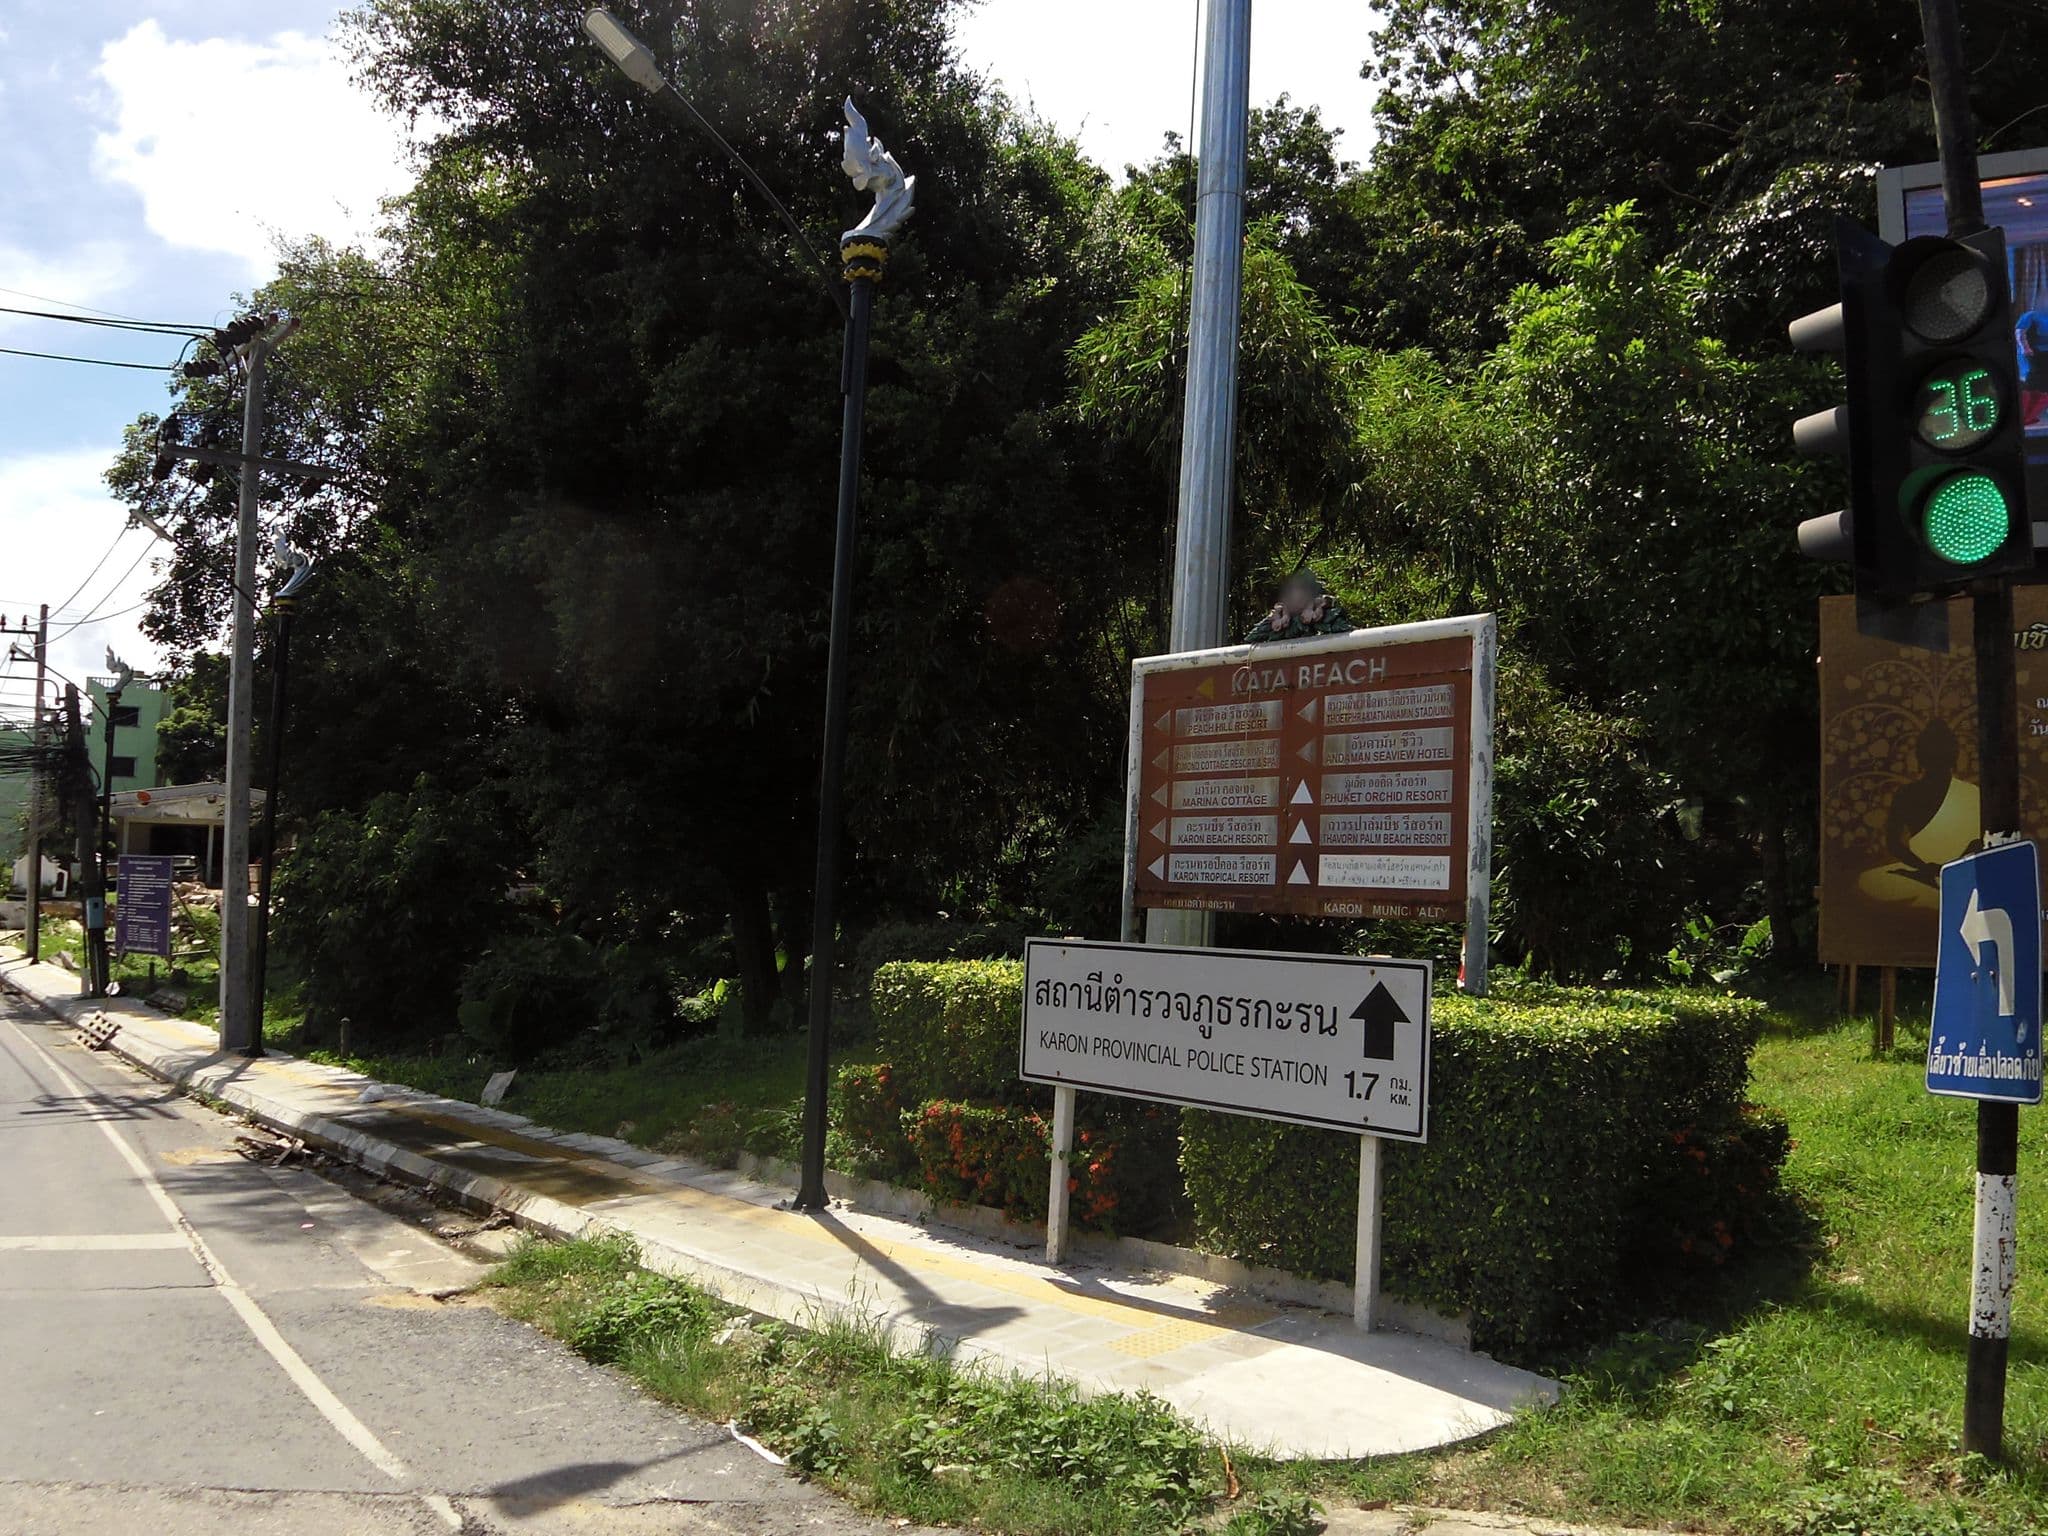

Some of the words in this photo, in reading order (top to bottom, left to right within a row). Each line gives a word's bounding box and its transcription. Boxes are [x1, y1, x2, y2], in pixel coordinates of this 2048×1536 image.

[1930, 371, 1996, 441] 36
[1232, 668, 1289, 695] KATA
[1299, 657, 1387, 690] BEACH
[1188, 724, 1214, 735] PEACH
[1215, 722, 1233, 733] HILL
[1235, 719, 1268, 731] RESORT
[1327, 752, 1371, 764] ANDAMAN
[1373, 749, 1415, 761] SEAVIEW
[1417, 747, 1450, 759] HOTEL
[1201, 759, 1229, 770] COTTAGE
[1183, 797, 1218, 807] MARINA
[1221, 794, 1268, 806] COTTAGE
[1324, 792, 1363, 803] PHUKET
[1365, 791, 1403, 802] ORCHID
[1406, 789, 1448, 801] RESORT
[1178, 835, 1204, 844] KARON
[1206, 834, 1234, 844] BEACH
[1235, 834, 1268, 844] RESORT
[1323, 833, 1358, 844] THAVORN
[1359, 833, 1382, 844] PALM
[1383, 833, 1411, 844] BEACH
[1413, 833, 1447, 844] RESORT
[1173, 871, 1199, 881] KARON
[1201, 871, 1237, 882] TROPICAL
[1238, 873, 1270, 883] RESORT
[1324, 903, 1362, 914] KARON
[1035, 971, 1338, 1039] สถานีตำรวจภูธรกะรน
[1040, 1030, 1088, 1055] KARON
[1093, 1036, 1181, 1067] PROVINCIAL
[1188, 1049, 1244, 1076] POLICE
[1250, 1056, 1327, 1086] STATION
[1929, 1036, 2040, 1080] เลี้ยวซ้ายเมื่อปลอดภัย
[1343, 1070, 1379, 1101] 1.7
[1390, 1076, 1412, 1092] กม.
[1390, 1093, 1411, 1106] KM.
